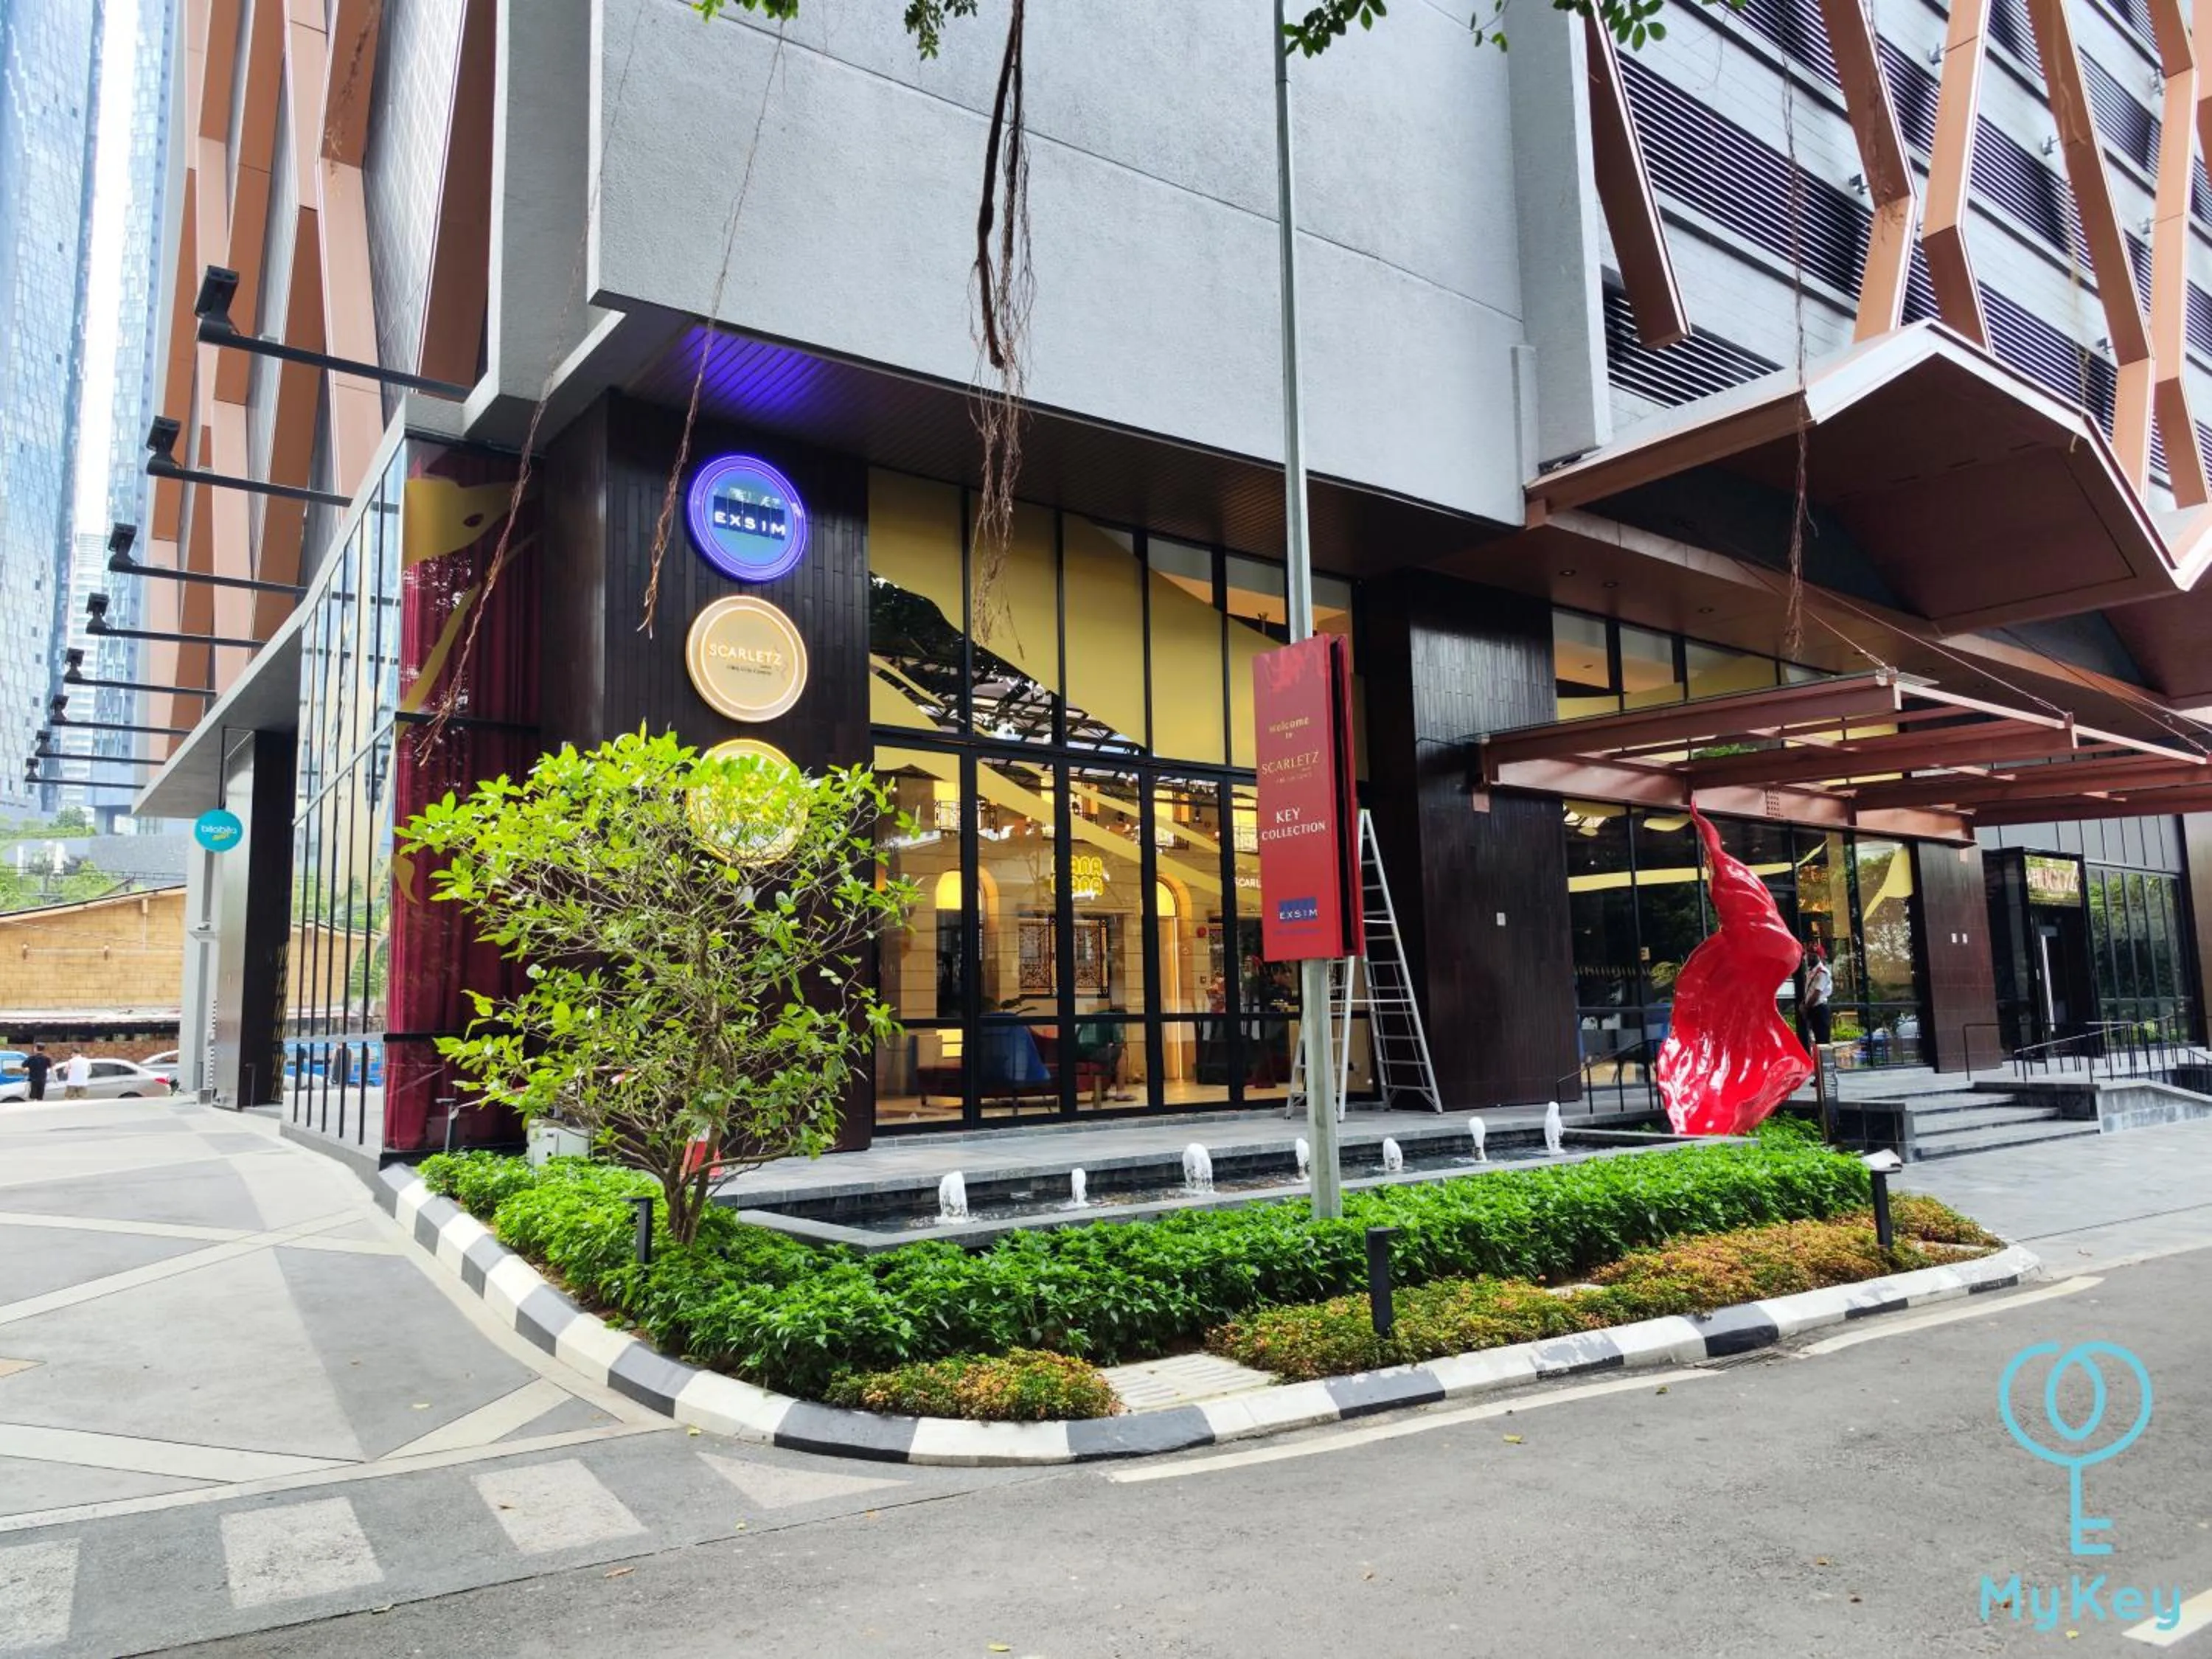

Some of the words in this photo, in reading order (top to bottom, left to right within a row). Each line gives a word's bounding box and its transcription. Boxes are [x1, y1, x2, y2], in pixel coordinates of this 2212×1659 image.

[714, 511, 785, 536] EXSIM
[708, 644, 782, 666] SCARLETZ
[1262, 748, 1320, 775] SCARLETZ
[1276, 807, 1301, 824] KEY
[1262, 820, 1326, 841] COLLECTION
[1279, 908, 1318, 920] EXSIM
